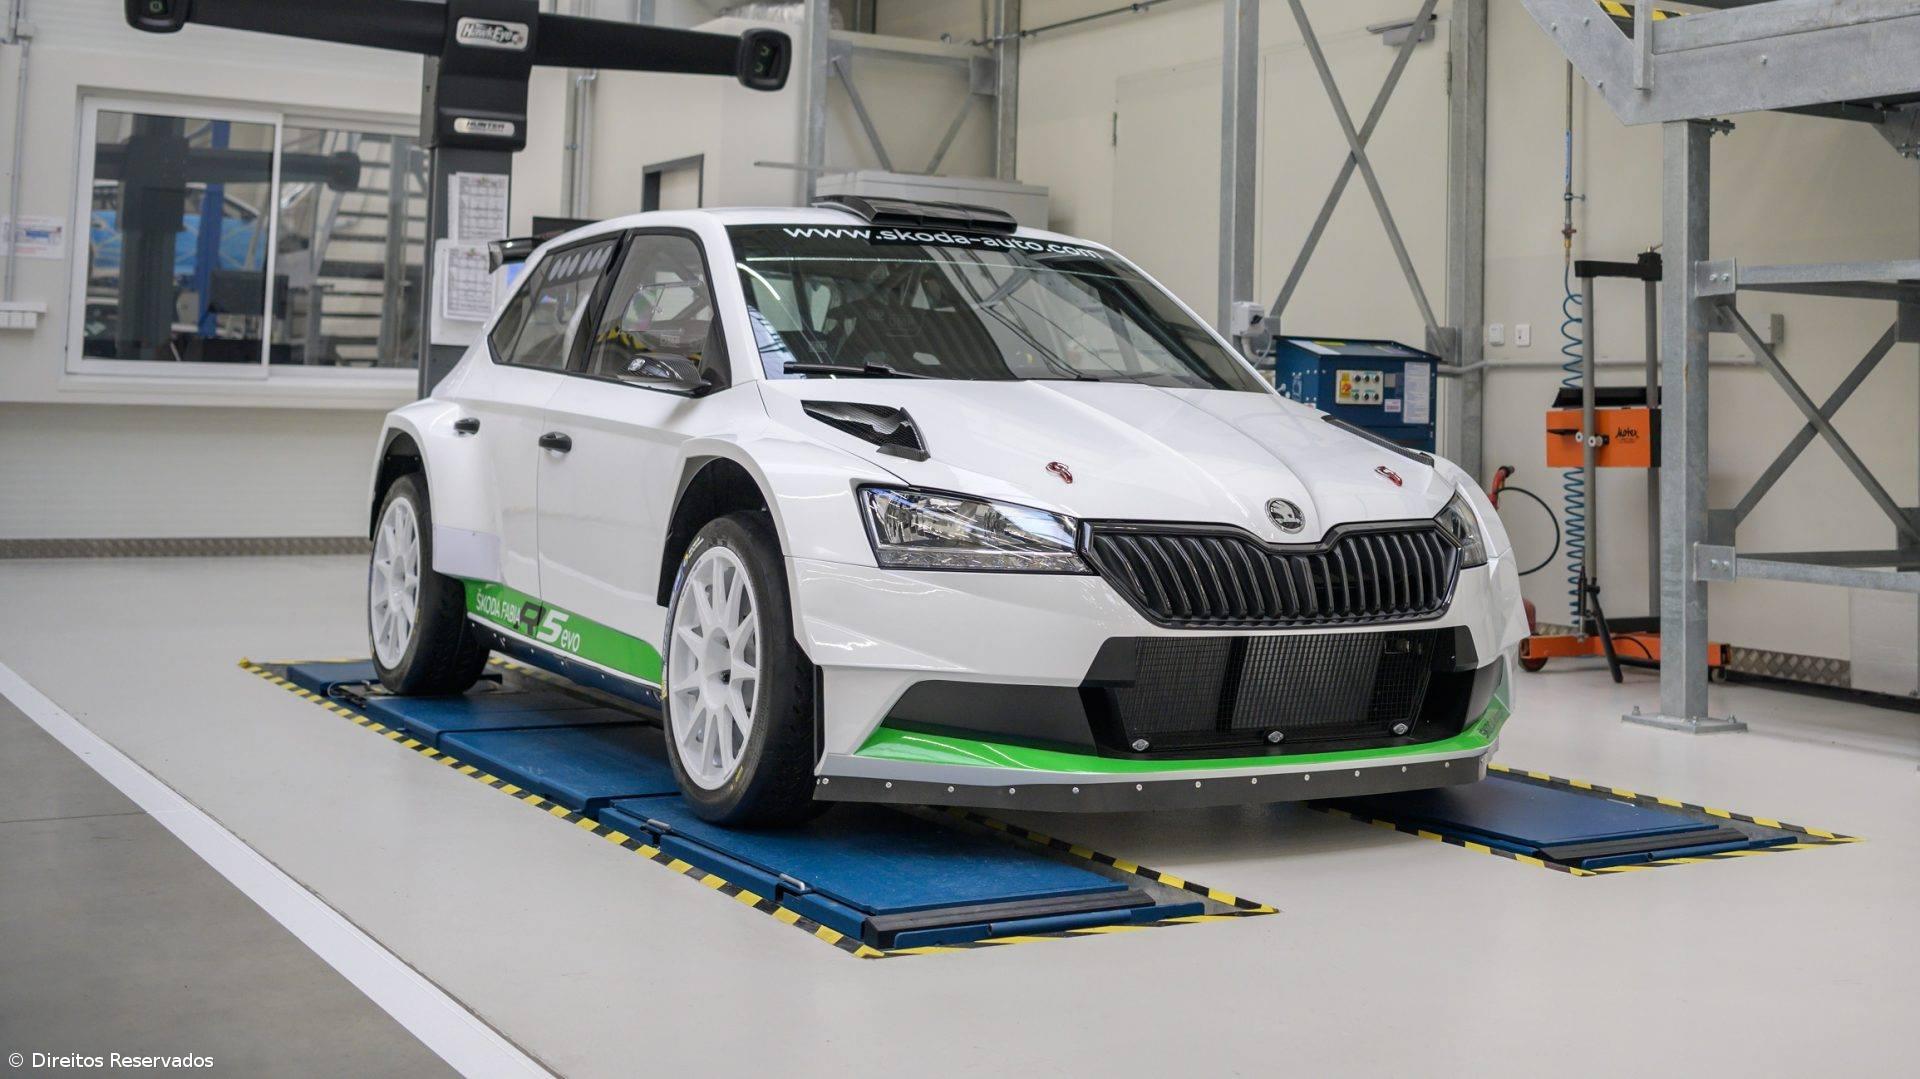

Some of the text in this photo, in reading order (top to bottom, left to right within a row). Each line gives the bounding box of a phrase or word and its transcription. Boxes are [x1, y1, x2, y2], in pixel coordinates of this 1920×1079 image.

[783, 227, 1105, 260] www.skoda-auto.com
[476, 588, 581, 653] ŠKODA FABIA R5 evo
